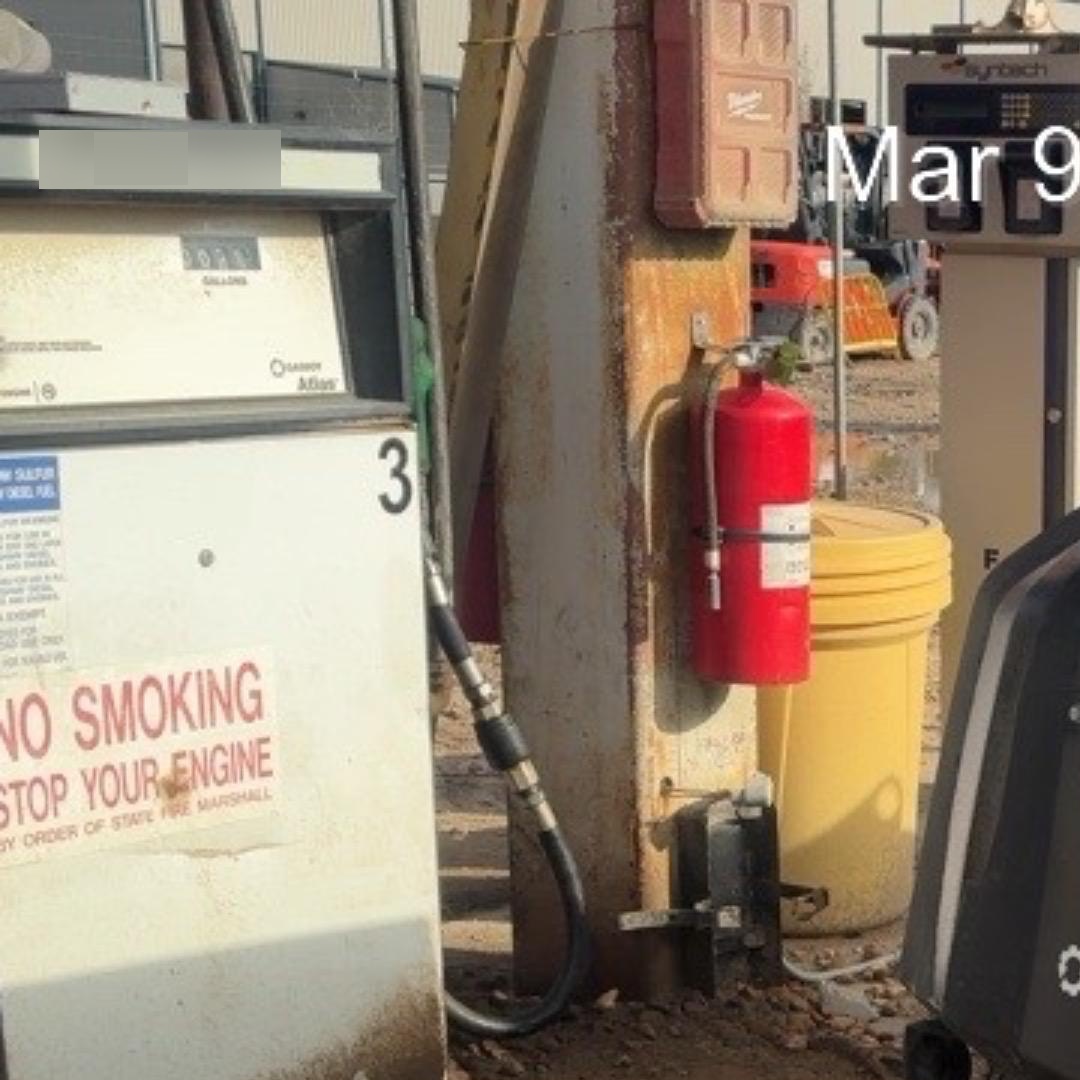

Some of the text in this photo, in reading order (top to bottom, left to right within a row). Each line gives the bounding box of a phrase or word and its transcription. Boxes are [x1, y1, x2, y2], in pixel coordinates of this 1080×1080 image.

[965, 62, 1048, 82] syntech
[377, 437, 413, 515] 3
[0, 661, 264, 763] NO SMOKING
[81, 758, 161, 811] YOUR
[171, 737, 273, 790] ENGINE
[24, 824, 79, 848] ORDER
[84, 818, 105, 835] OF
[111, 810, 155, 831] STATE
[197, 787, 273, 812] MARSHALL
